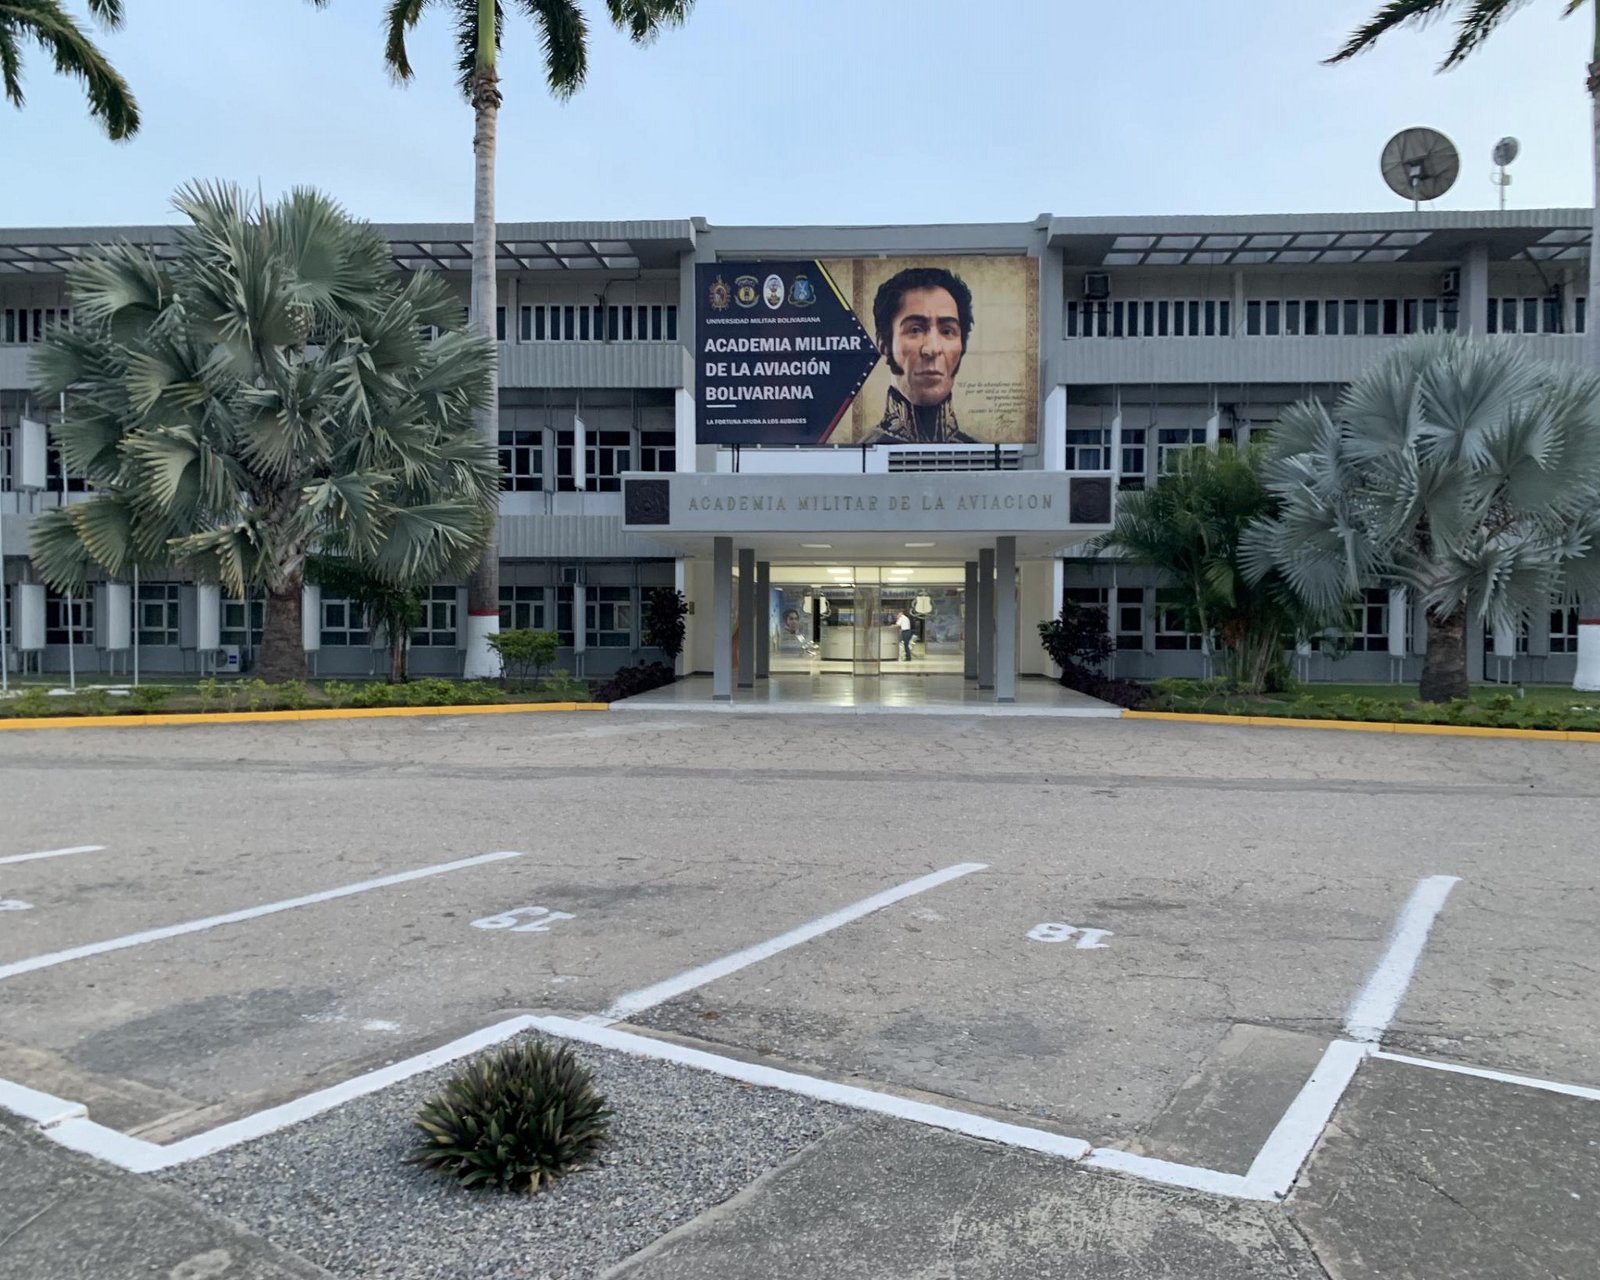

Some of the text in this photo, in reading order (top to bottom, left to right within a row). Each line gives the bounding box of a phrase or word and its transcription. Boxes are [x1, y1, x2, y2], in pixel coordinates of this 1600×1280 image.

[777, 316, 821, 324] BOLIVARIANA
[704, 336, 861, 353] ACADEMIA MILITAR
[705, 357, 831, 377] DE LA AVIACIÓN
[705, 386, 814, 401] BOLIVARIANA
[688, 494, 1053, 511] ACADEMIA MILITAR DE LA AVIACION
